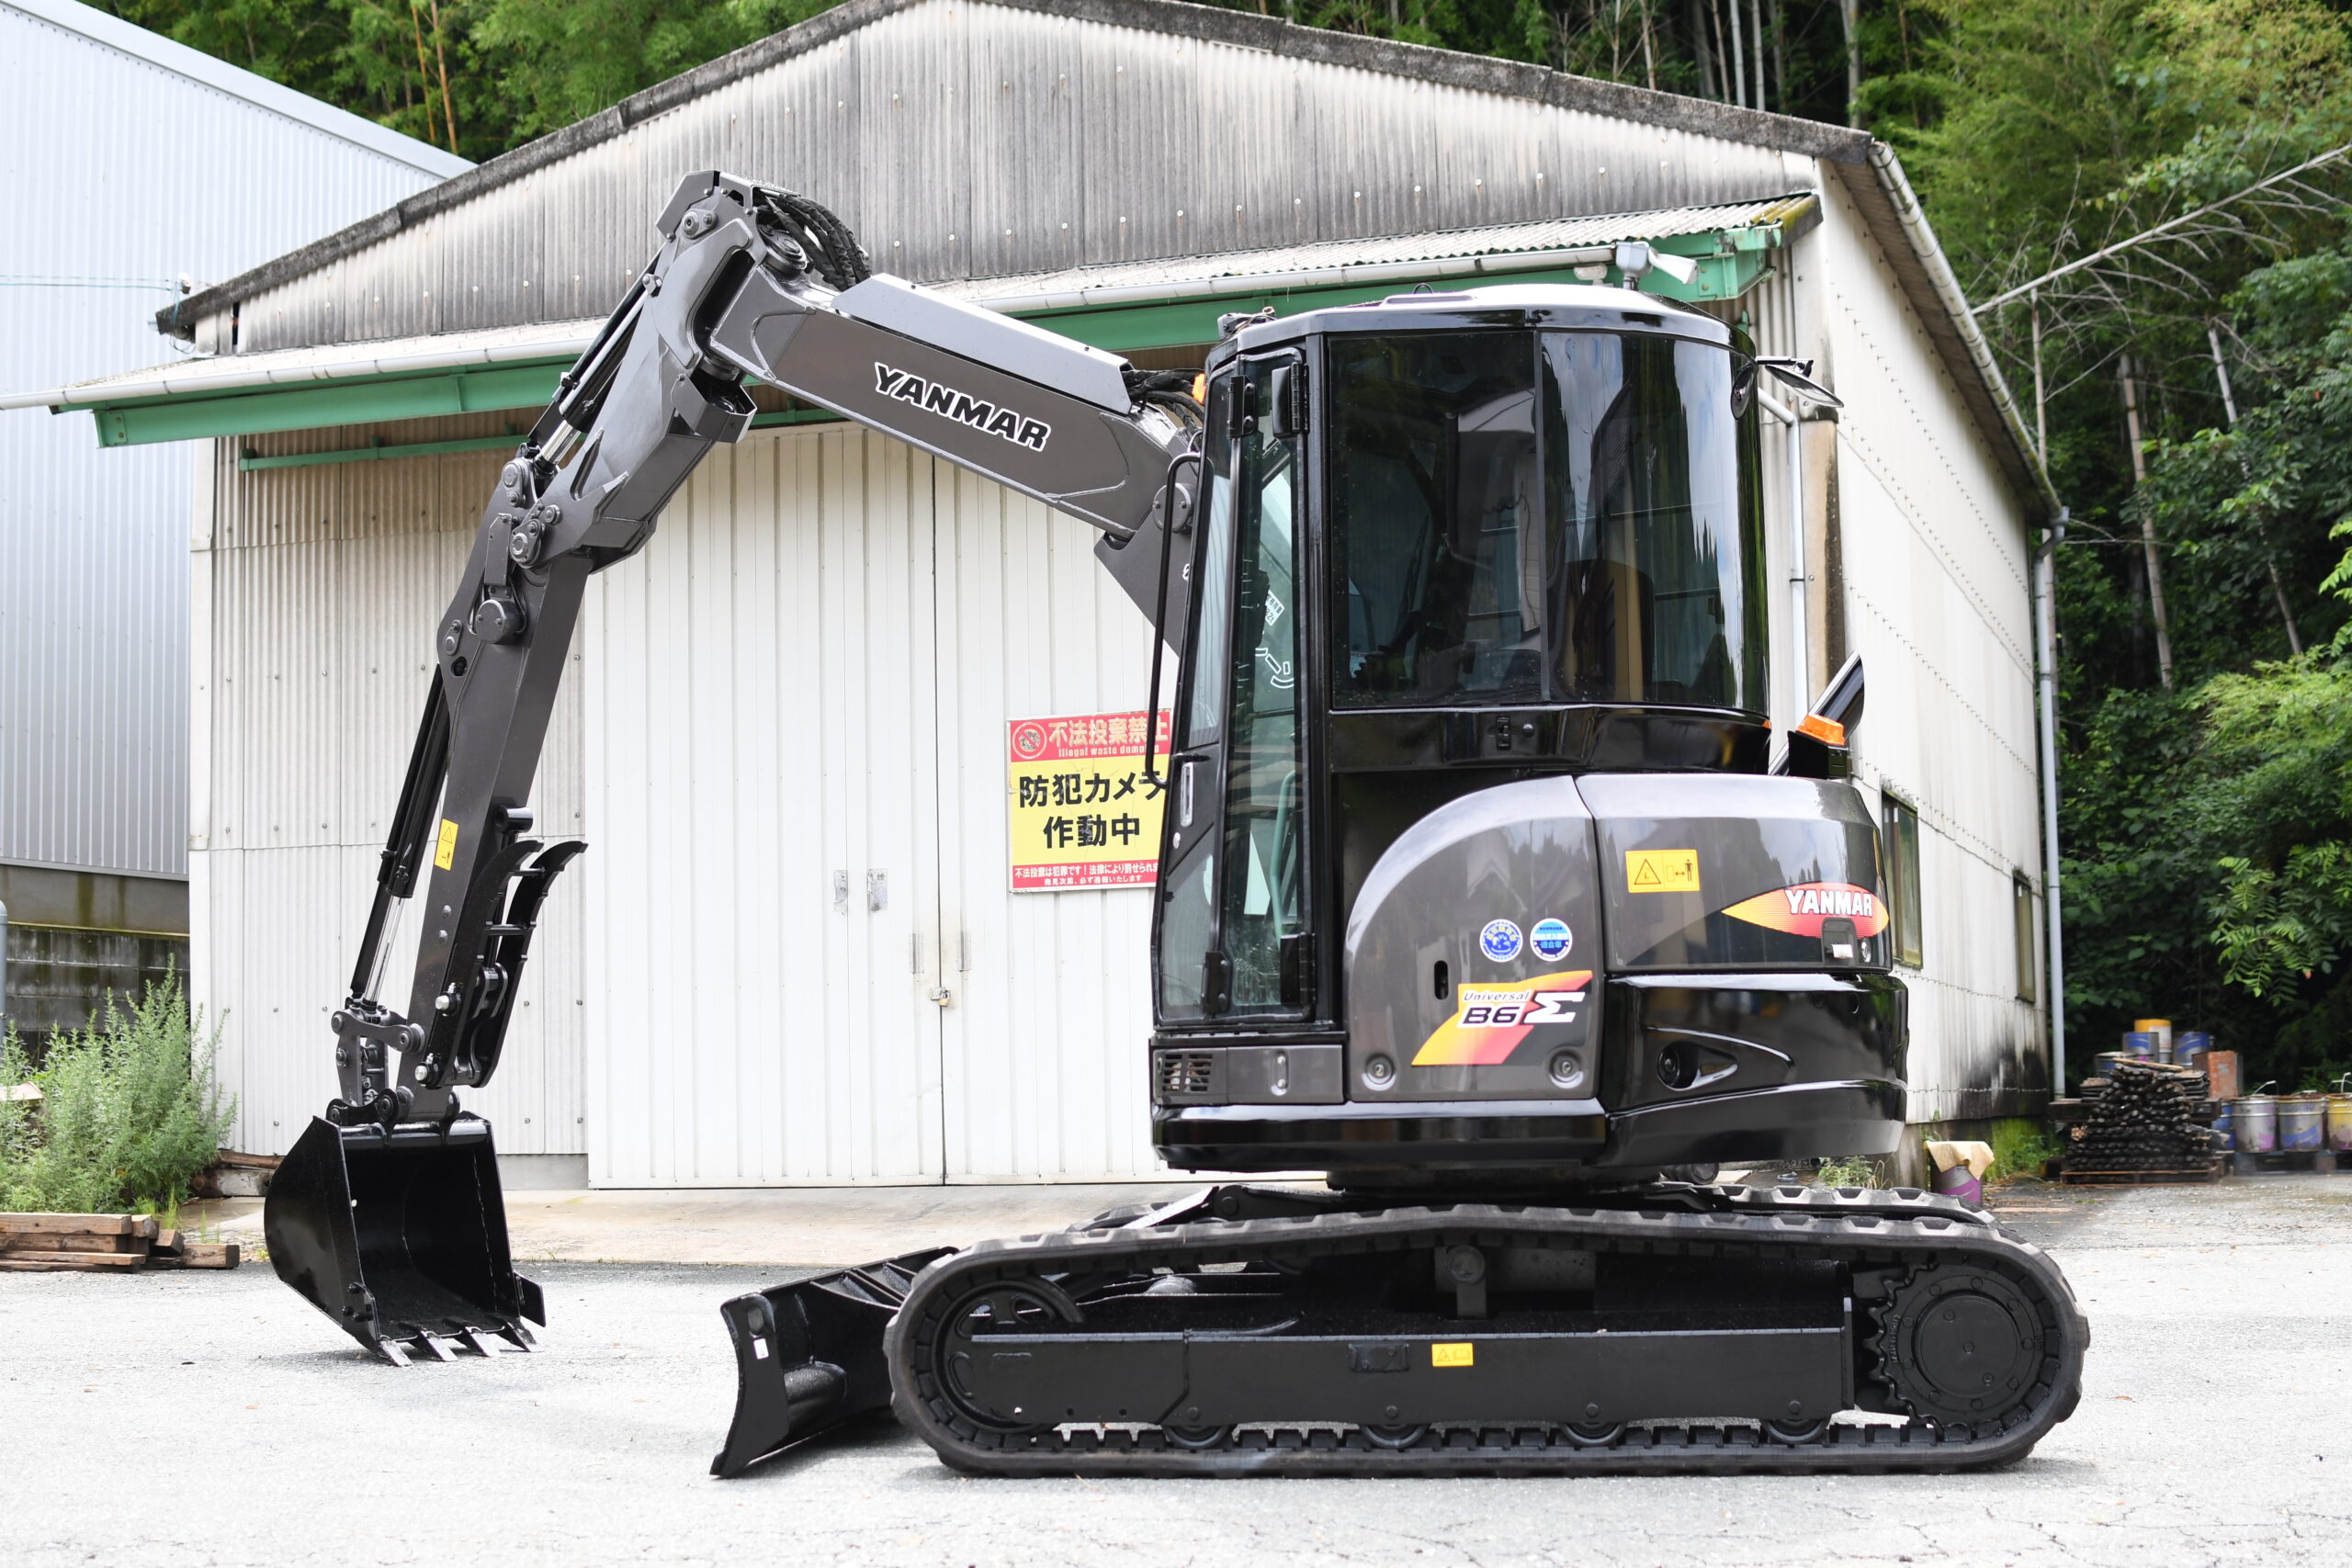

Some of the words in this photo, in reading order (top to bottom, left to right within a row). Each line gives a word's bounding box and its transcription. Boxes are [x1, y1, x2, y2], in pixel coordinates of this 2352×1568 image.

[874, 362, 1051, 452] YANMAR
[1048, 715, 1168, 748] 不法投棄禁止
[1058, 747, 1088, 758] Illegal
[1091, 746, 1117, 757] waste
[1019, 770, 1166, 808] 防犯カメラ
[1044, 813, 1140, 849] 作動中
[1784, 889, 1872, 917] YANMAR
[1464, 991, 1530, 1001] Universal
